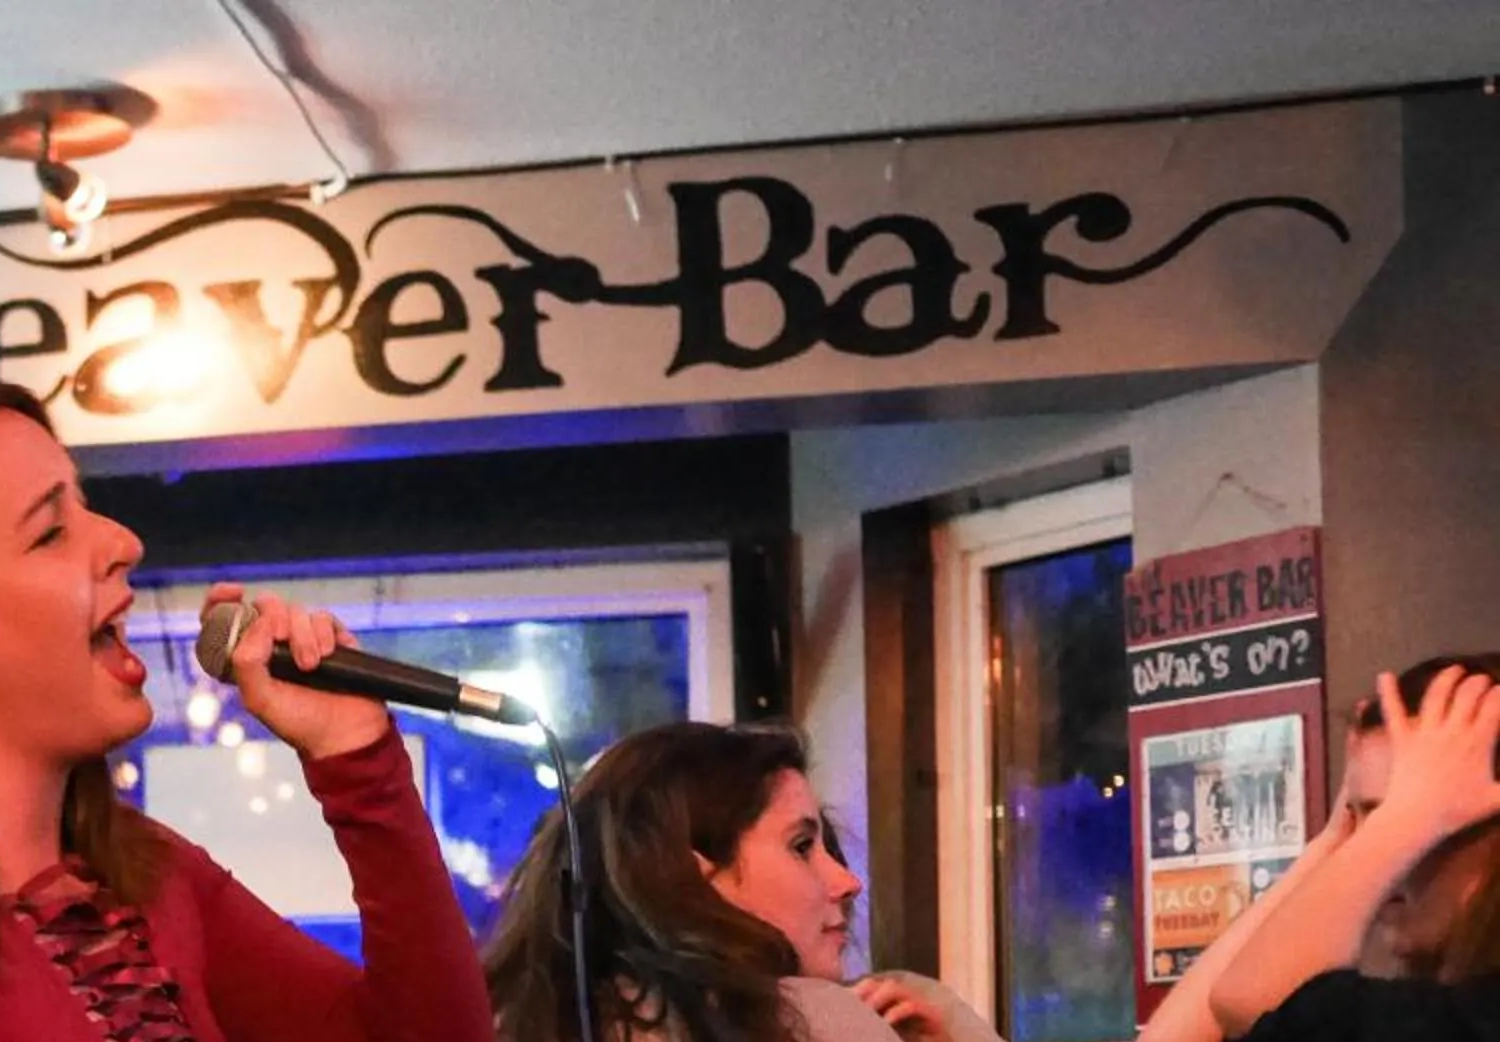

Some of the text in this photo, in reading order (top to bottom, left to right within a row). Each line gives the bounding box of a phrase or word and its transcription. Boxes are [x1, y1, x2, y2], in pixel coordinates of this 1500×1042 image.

[664, 176, 1350, 376] Bar
[1126, 569, 1248, 638] BEAVER
[1256, 556, 1315, 612] BAR
[1153, 883, 1216, 911] TACO
